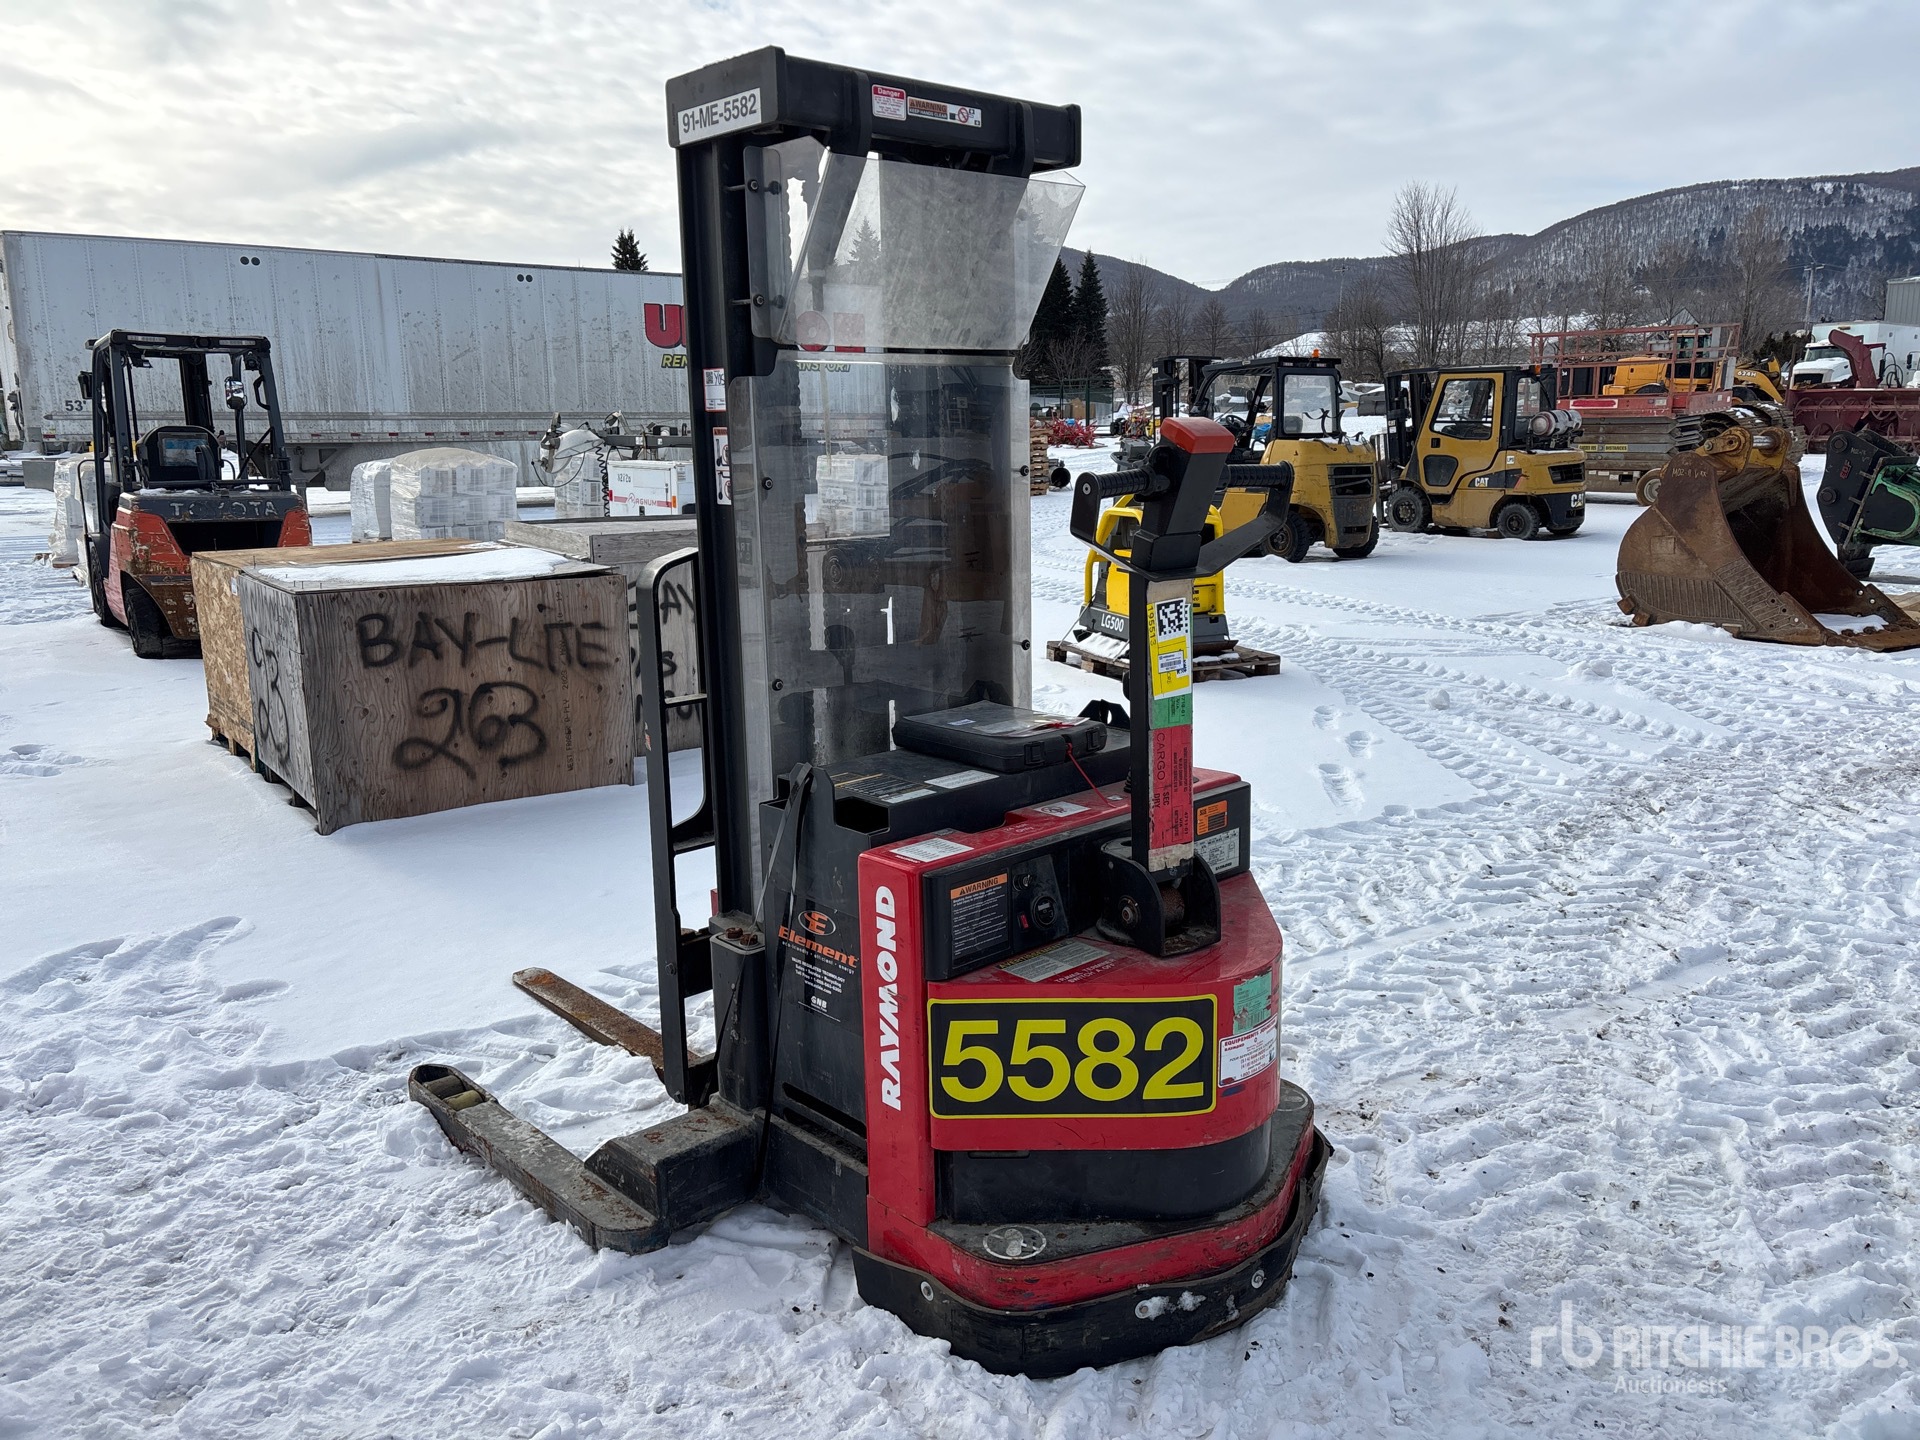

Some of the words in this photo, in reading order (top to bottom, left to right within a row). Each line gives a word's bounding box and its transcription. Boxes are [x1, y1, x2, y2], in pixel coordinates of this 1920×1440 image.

[877, 87, 901, 98] Danger
[682, 93, 757, 133] 91-ME-5582
[914, 100, 947, 113] WARNING
[662, 355, 688, 368] REN
[1475, 477, 1489, 488] CAT
[1101, 614, 1125, 633] LG500
[1156, 732, 1165, 781] CARGO
[965, 876, 999, 895] WARNING
[778, 925, 859, 969] Element
[876, 885, 902, 1112] RAYMOND
[940, 1016, 1205, 1103] 5582
